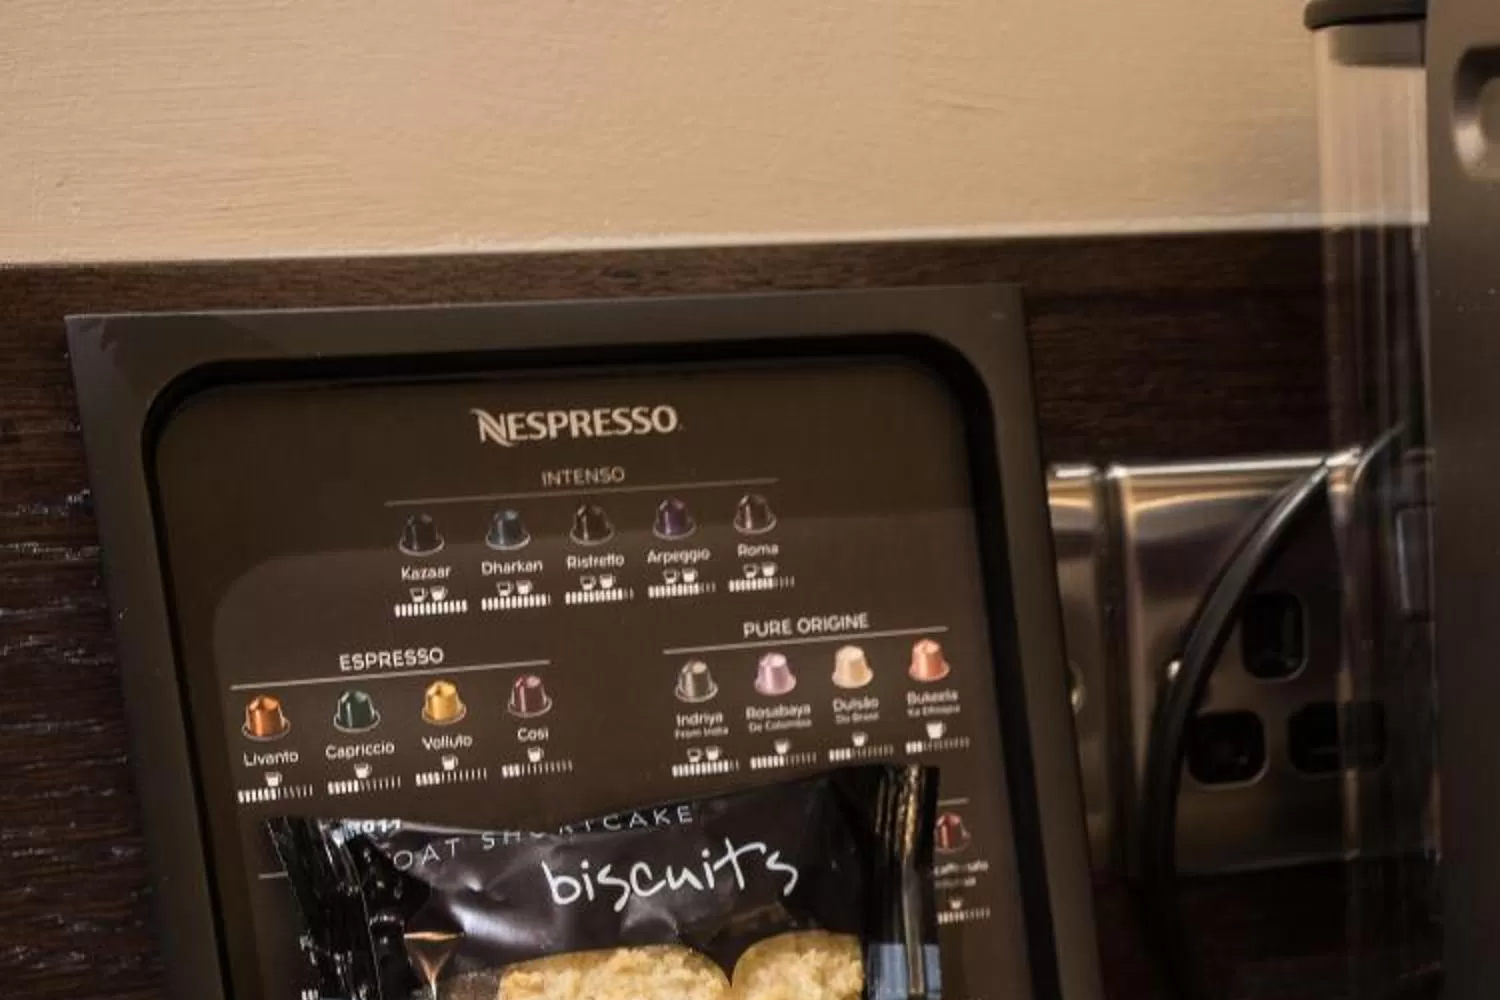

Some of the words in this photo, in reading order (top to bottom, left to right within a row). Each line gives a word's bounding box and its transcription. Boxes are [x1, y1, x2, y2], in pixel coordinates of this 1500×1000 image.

[470, 405, 678, 447] NESPRESSO
[541, 466, 625, 488] INTENSO
[647, 546, 711, 566] Arpeggio
[738, 541, 779, 557] Roma
[481, 557, 543, 577] Dharkan
[567, 552, 625, 570] Ristretto
[400, 563, 451, 581] Kazaar
[743, 617, 793, 639] PURE
[797, 612, 870, 634] ORIGINE
[339, 647, 444, 672] ESPRESSO
[243, 749, 299, 767] Livanto
[325, 740, 395, 761] Capriccio
[394, 837, 461, 872] OAT
[540, 837, 799, 913] biscuits
